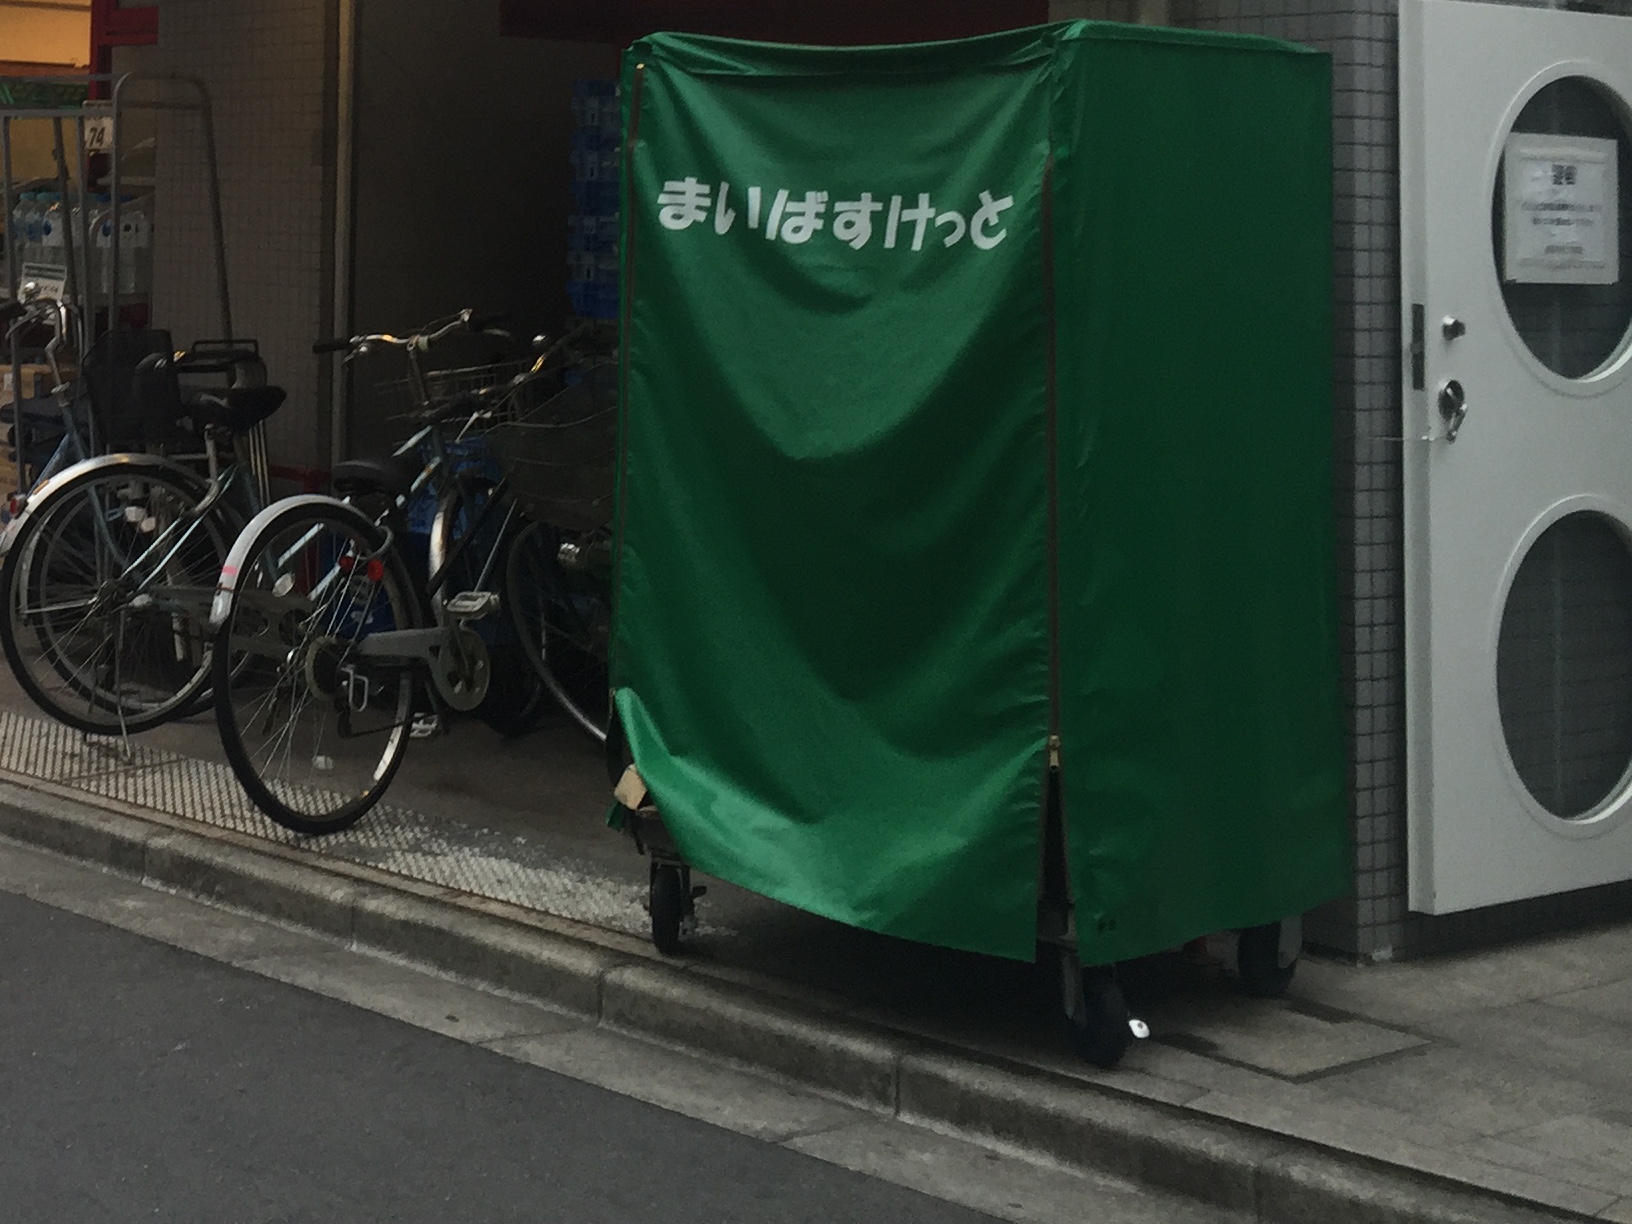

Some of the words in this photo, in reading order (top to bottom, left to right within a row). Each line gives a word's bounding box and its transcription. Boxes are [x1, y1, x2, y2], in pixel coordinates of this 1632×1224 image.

[89, 127, 106, 147] 74
[656, 176, 1014, 252] まいばすけっと
